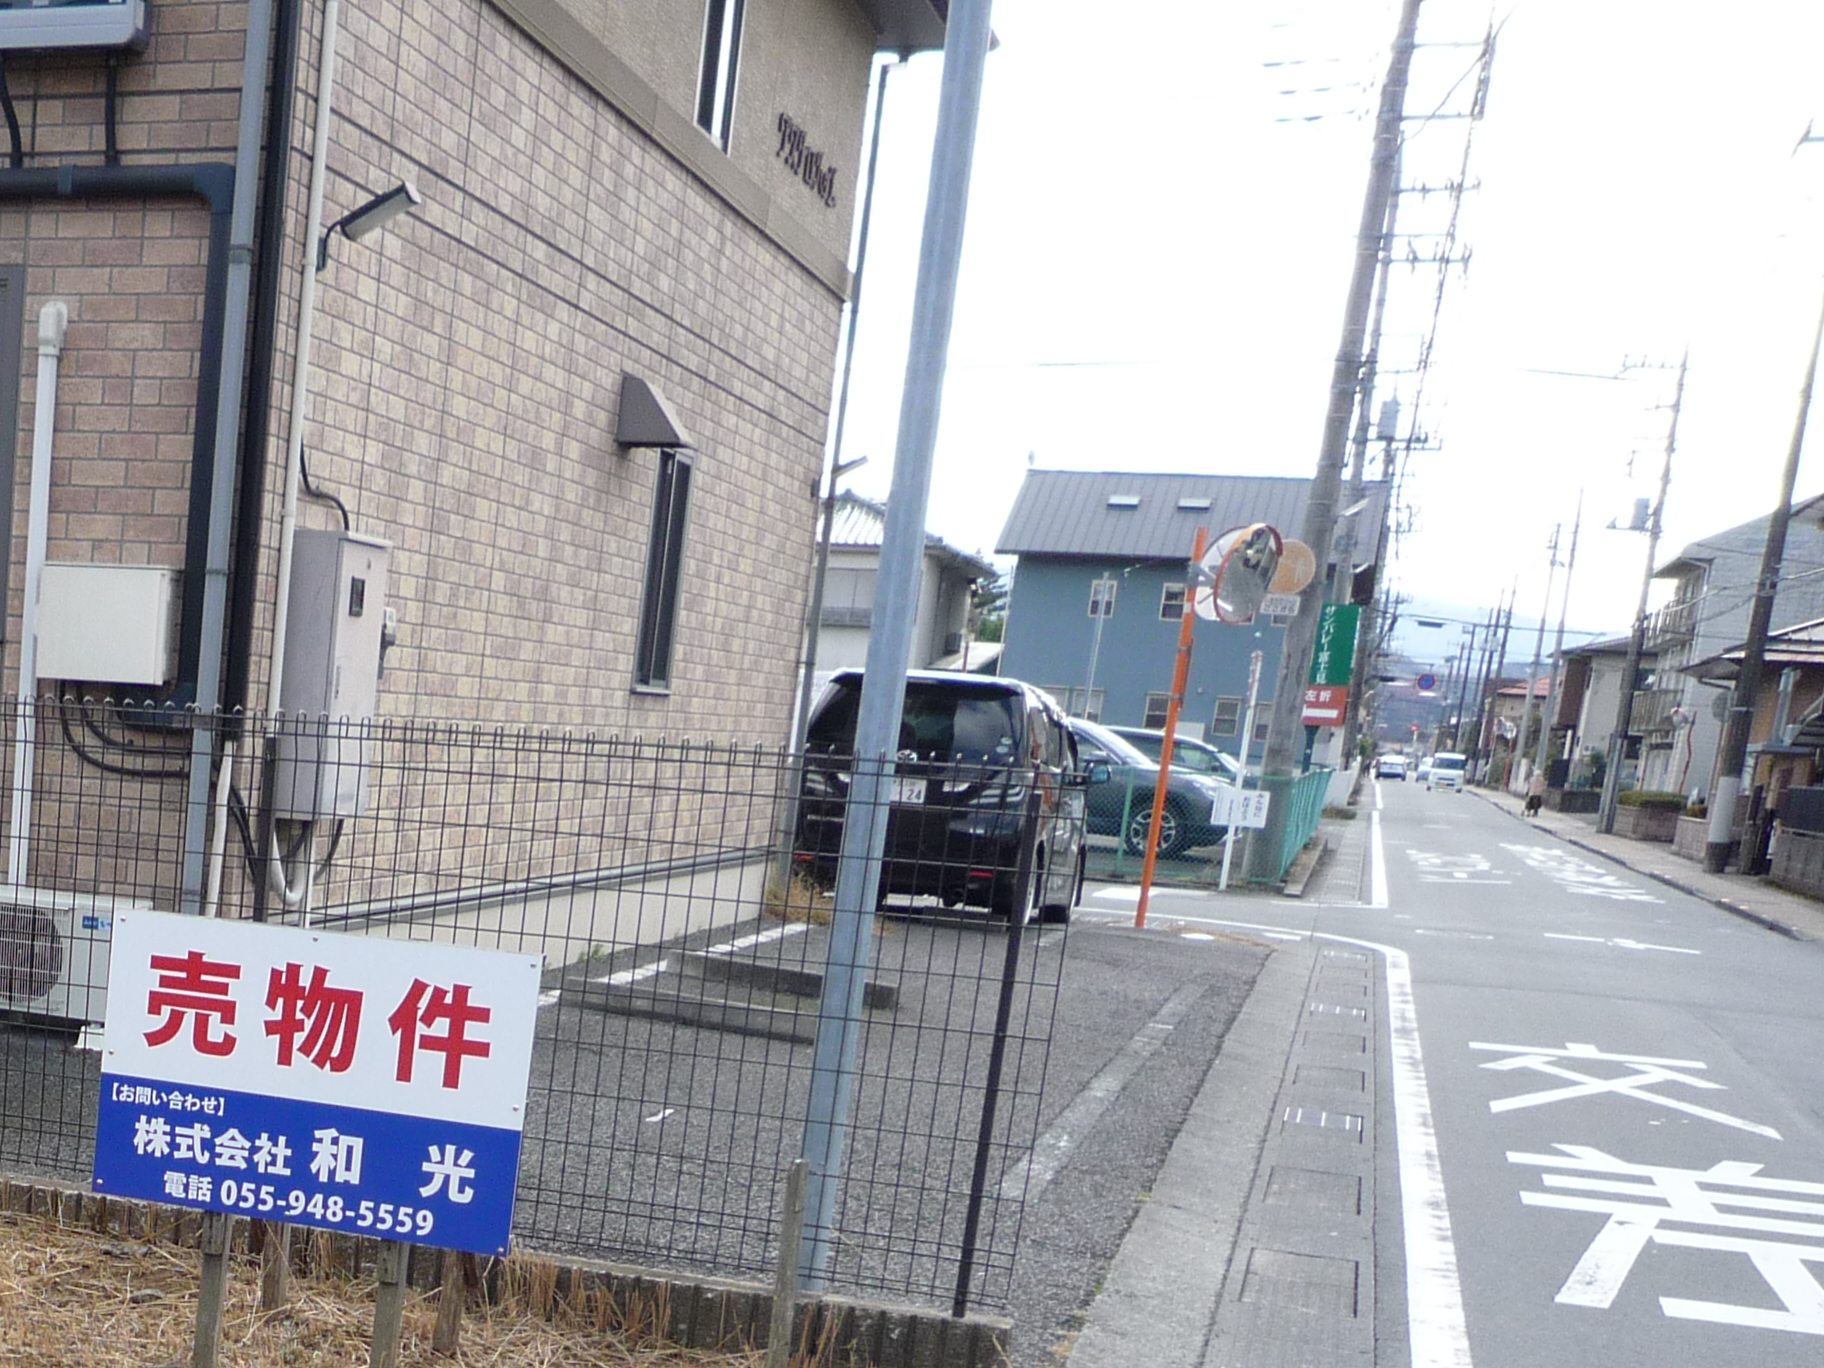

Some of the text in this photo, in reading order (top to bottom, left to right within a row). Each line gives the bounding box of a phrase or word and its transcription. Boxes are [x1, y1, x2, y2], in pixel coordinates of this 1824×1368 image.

[1305, 690, 1332, 702] 左折
[142, 950, 491, 1089] 売物件
[110, 1082, 225, 1116] 【お問い合わせ】
[133, 1116, 292, 1177] 株式会社
[163, 1171, 434, 1236] 電話 055-948-5559
